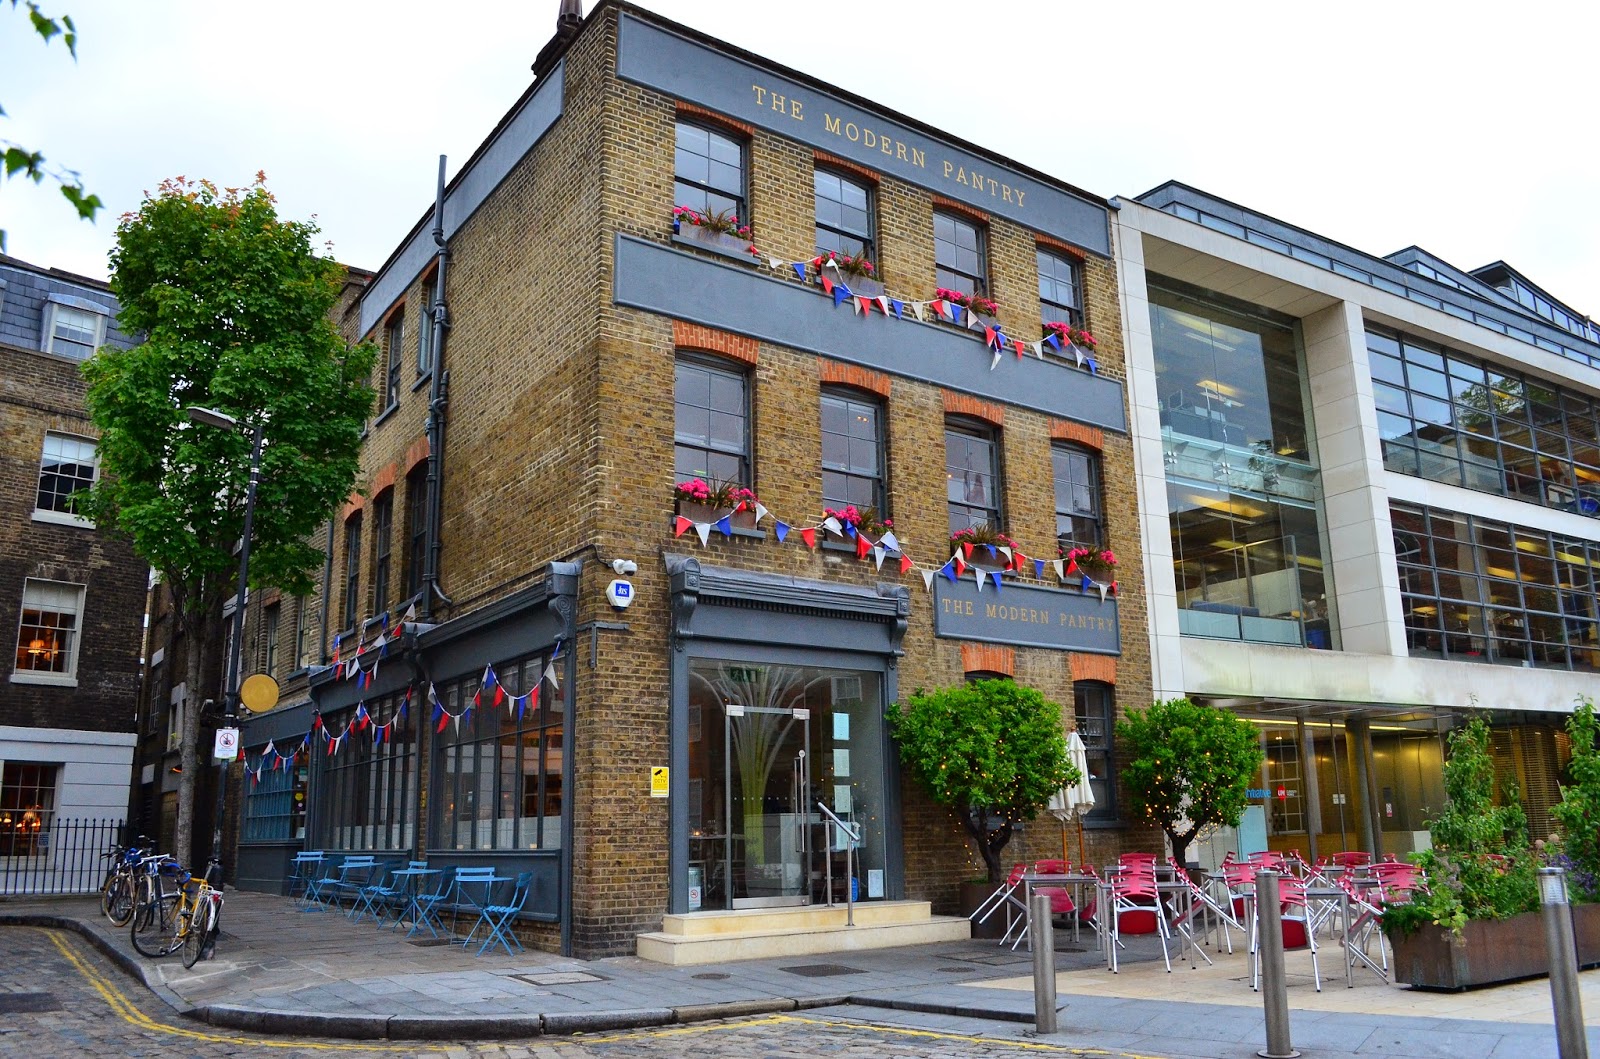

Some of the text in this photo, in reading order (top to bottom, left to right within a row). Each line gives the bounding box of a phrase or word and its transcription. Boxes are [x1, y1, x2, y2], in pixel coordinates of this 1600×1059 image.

[752, 85, 1026, 207] THE MODERN PANTRY
[942, 598, 1114, 633] THE MODERN PANTRY
